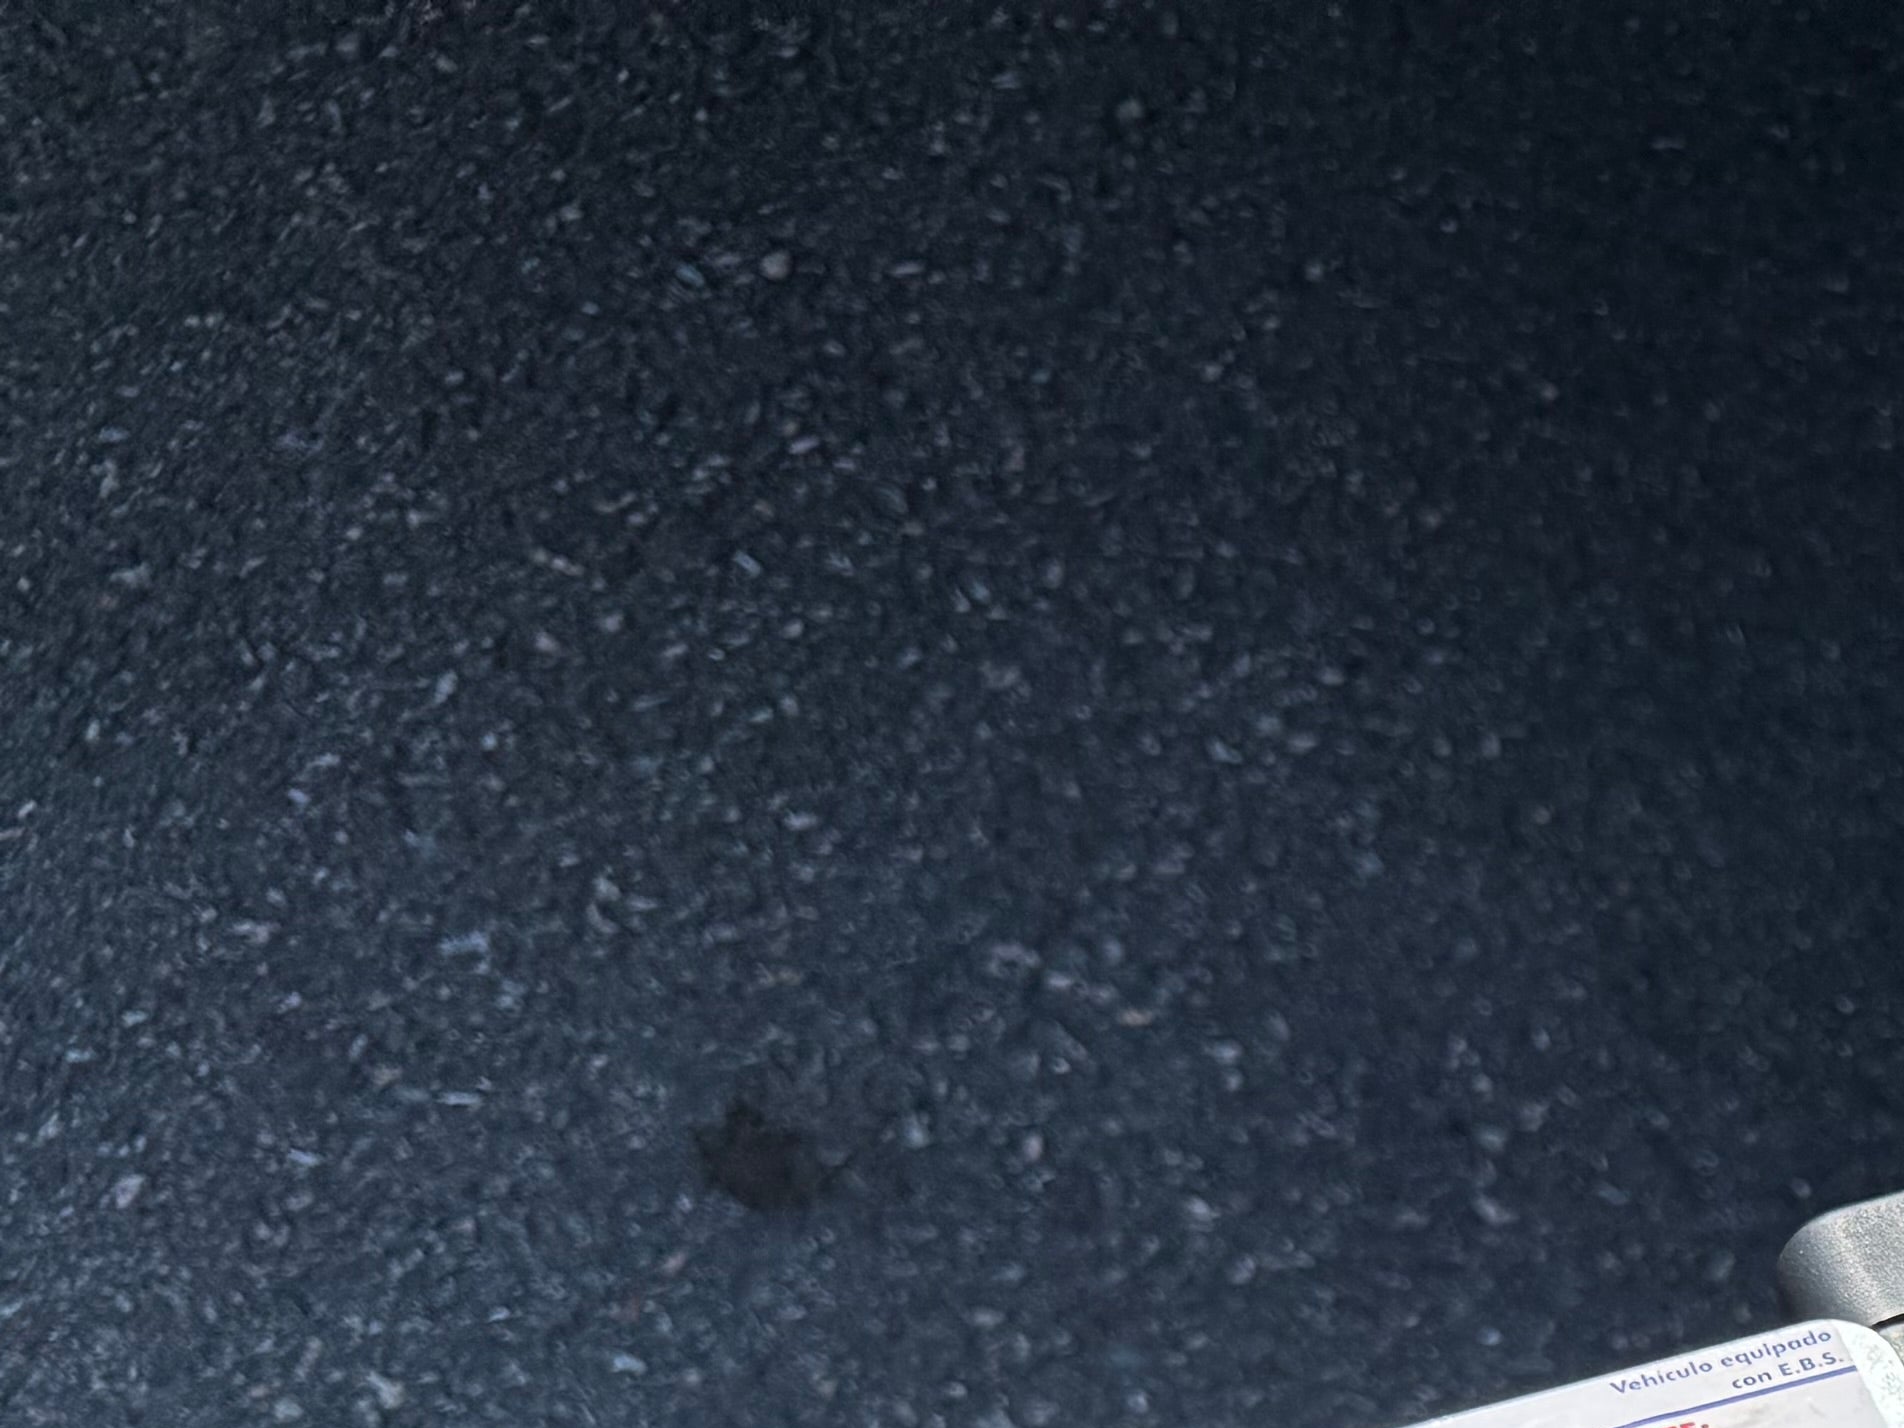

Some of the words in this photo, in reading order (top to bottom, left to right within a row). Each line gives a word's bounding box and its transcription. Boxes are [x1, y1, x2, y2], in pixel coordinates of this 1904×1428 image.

[1721, 1328, 1832, 1368] equipado
[1732, 1371, 1772, 1391] con
[1780, 1351, 1846, 1379] E.B.S.
